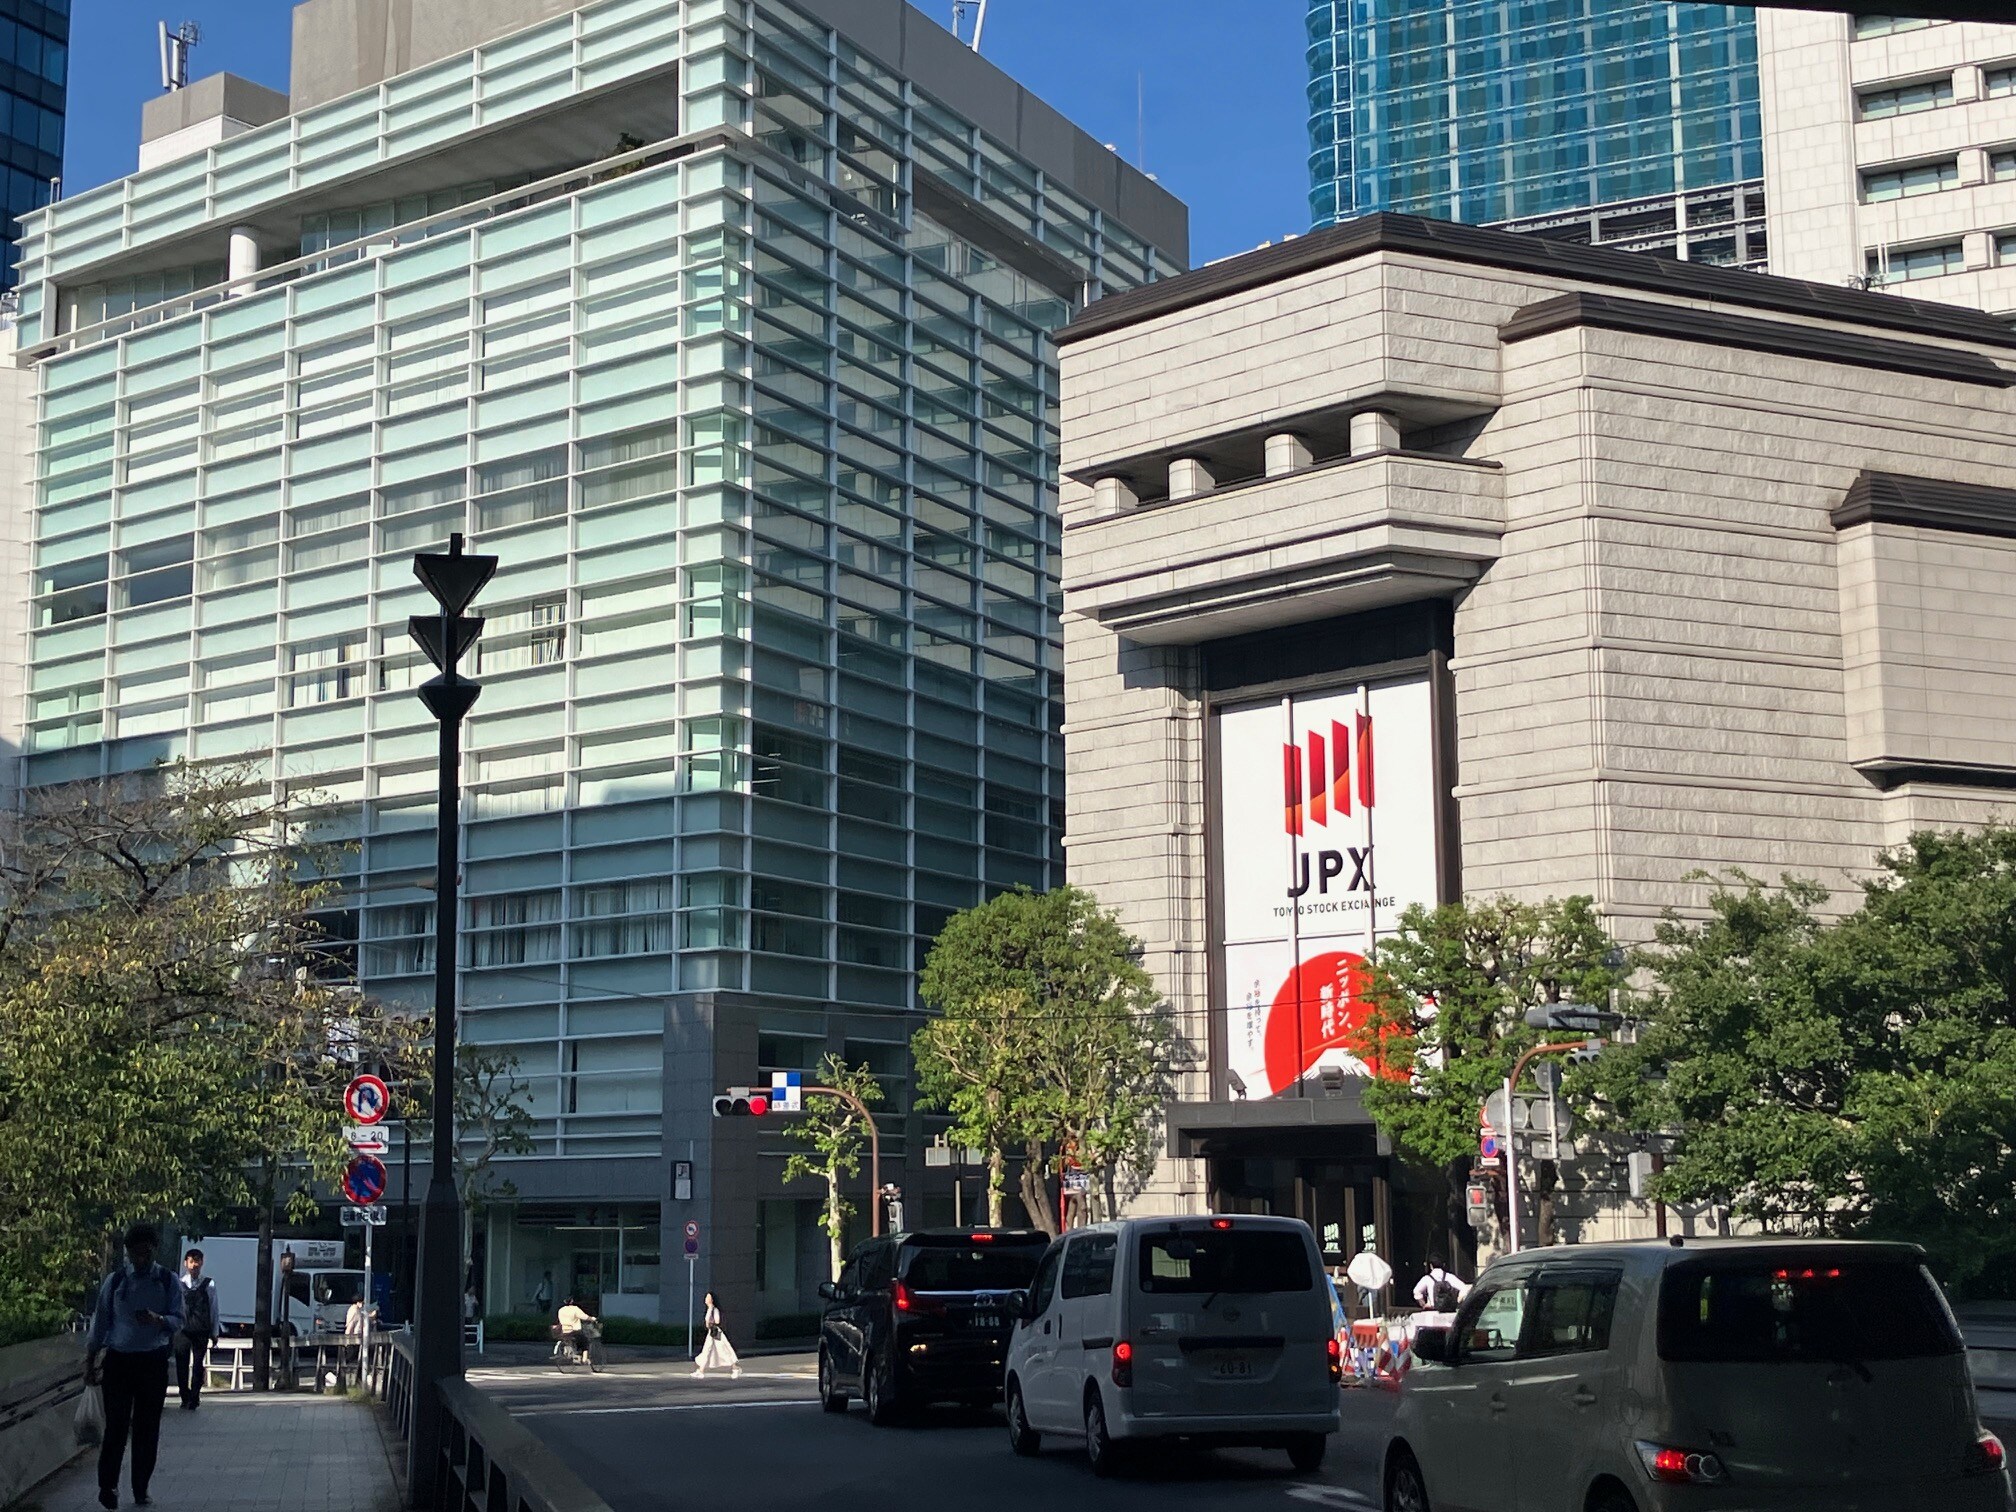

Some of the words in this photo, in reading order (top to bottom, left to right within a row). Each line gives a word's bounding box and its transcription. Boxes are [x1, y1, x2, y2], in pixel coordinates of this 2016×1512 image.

[1287, 845, 1376, 898] JPX
[1273, 905, 1304, 917] TOYO
[1307, 902, 1338, 915] STOCK
